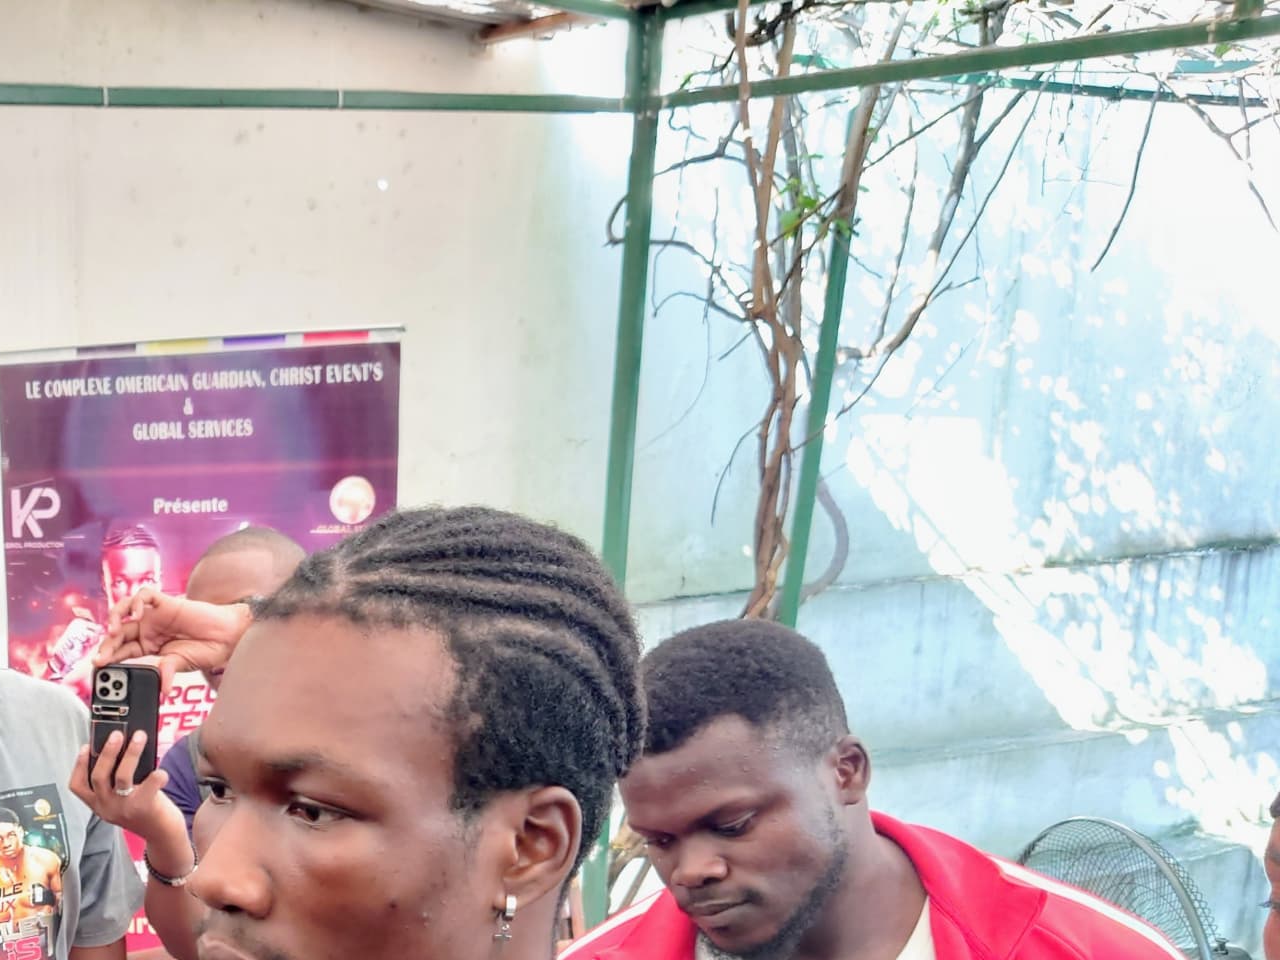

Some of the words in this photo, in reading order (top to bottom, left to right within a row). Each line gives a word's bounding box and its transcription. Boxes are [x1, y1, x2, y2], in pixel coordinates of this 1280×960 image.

[25, 381, 41, 399] LE
[44, 376, 112, 398] COMPLEXE
[115, 373, 188, 394] OMERICAIN
[192, 370, 266, 391] GUARDIAN,
[270, 366, 322, 387] CHRIST
[326, 362, 384, 384] EVENT'S
[183, 397, 193, 415] &
[133, 421, 185, 441] GLOBAL
[188, 418, 253, 439] SERVICES
[11, 487, 61, 538] KP
[153, 497, 228, 514] Présente
